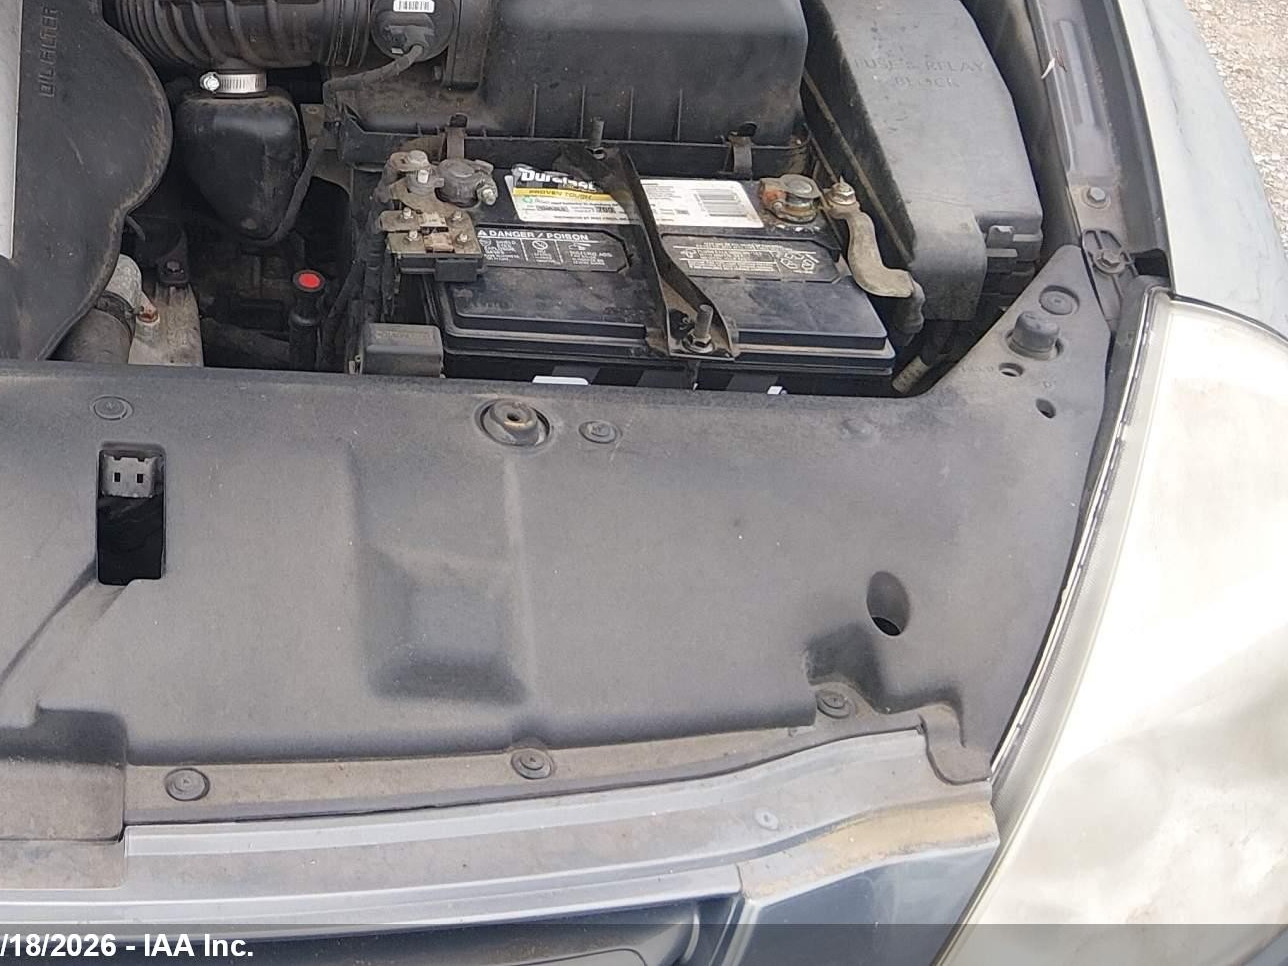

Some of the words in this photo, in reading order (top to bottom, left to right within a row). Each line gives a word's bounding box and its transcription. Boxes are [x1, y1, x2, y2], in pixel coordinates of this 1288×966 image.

[529, 189, 562, 197] PROVEN
[565, 192, 593, 200] TOUGH
[489, 230, 535, 238] DANGER
[546, 232, 589, 242] POISON
